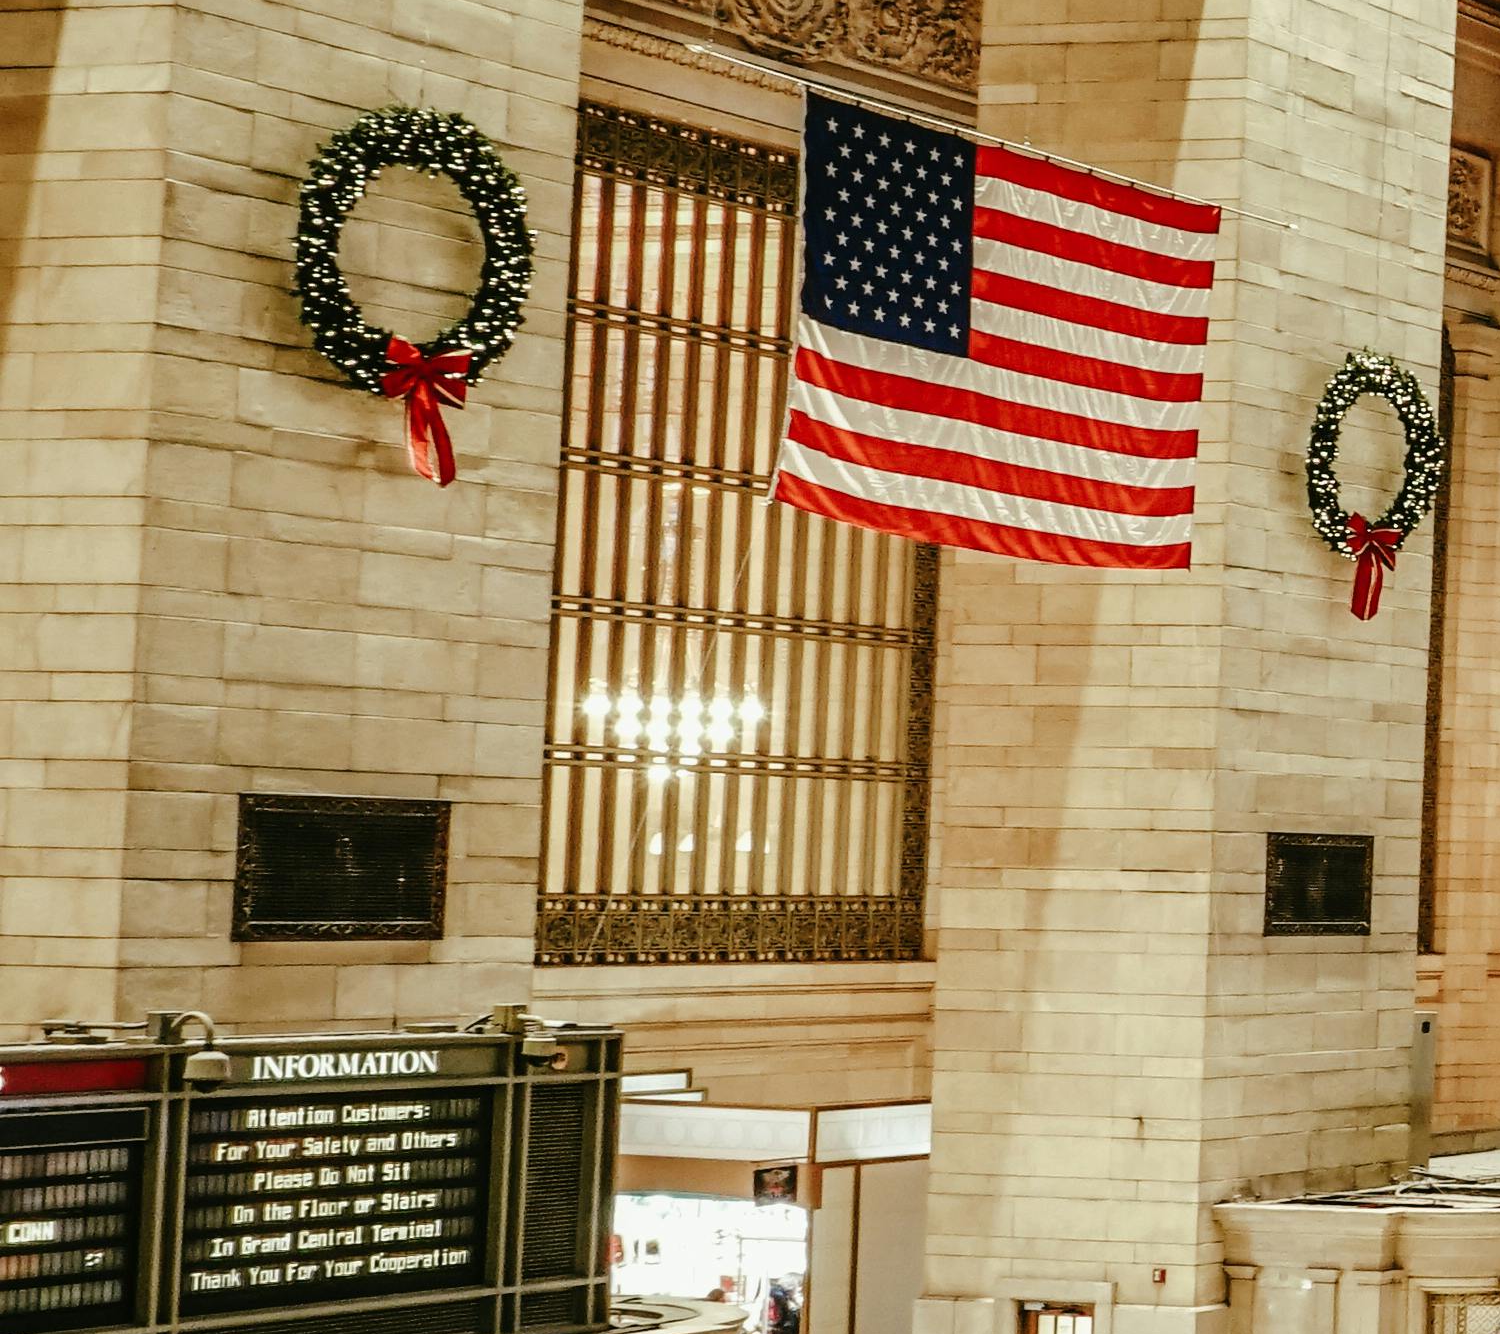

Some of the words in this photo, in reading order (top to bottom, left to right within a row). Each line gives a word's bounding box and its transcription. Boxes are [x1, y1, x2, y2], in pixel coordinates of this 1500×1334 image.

[252, 1050, 440, 1080] INFORMATION
[247, 1105, 335, 1128] Attention
[342, 1102, 430, 1124] Customers:
[215, 1142, 249, 1162] For
[256, 1141, 295, 1160] Your
[302, 1137, 360, 1157] Safety
[366, 1133, 396, 1153] and
[401, 1131, 457, 1151] Others
[253, 1169, 313, 1192] Please
[319, 1167, 340, 1187] Do
[346, 1164, 375, 1184] Not
[382, 1162, 411, 1182] Sit
[233, 1205, 254, 1225] On
[263, 1202, 293, 1222] the
[299, 1198, 349, 1219] Floor
[354, 1197, 377, 1215] or
[381, 1192, 439, 1212] Stairs
[210, 1238, 234, 1258] In
[240, 1233, 291, 1256] Grand
[298, 1226, 363, 1250] Central
[371, 1219, 442, 1243] Terminal
[190, 1269, 242, 1292] Thank
[249, 1265, 281, 1287] You
[286, 1263, 319, 1283] For
[324, 1258, 364, 1279] Your
[369, 1248, 470, 1274] Cooperation
